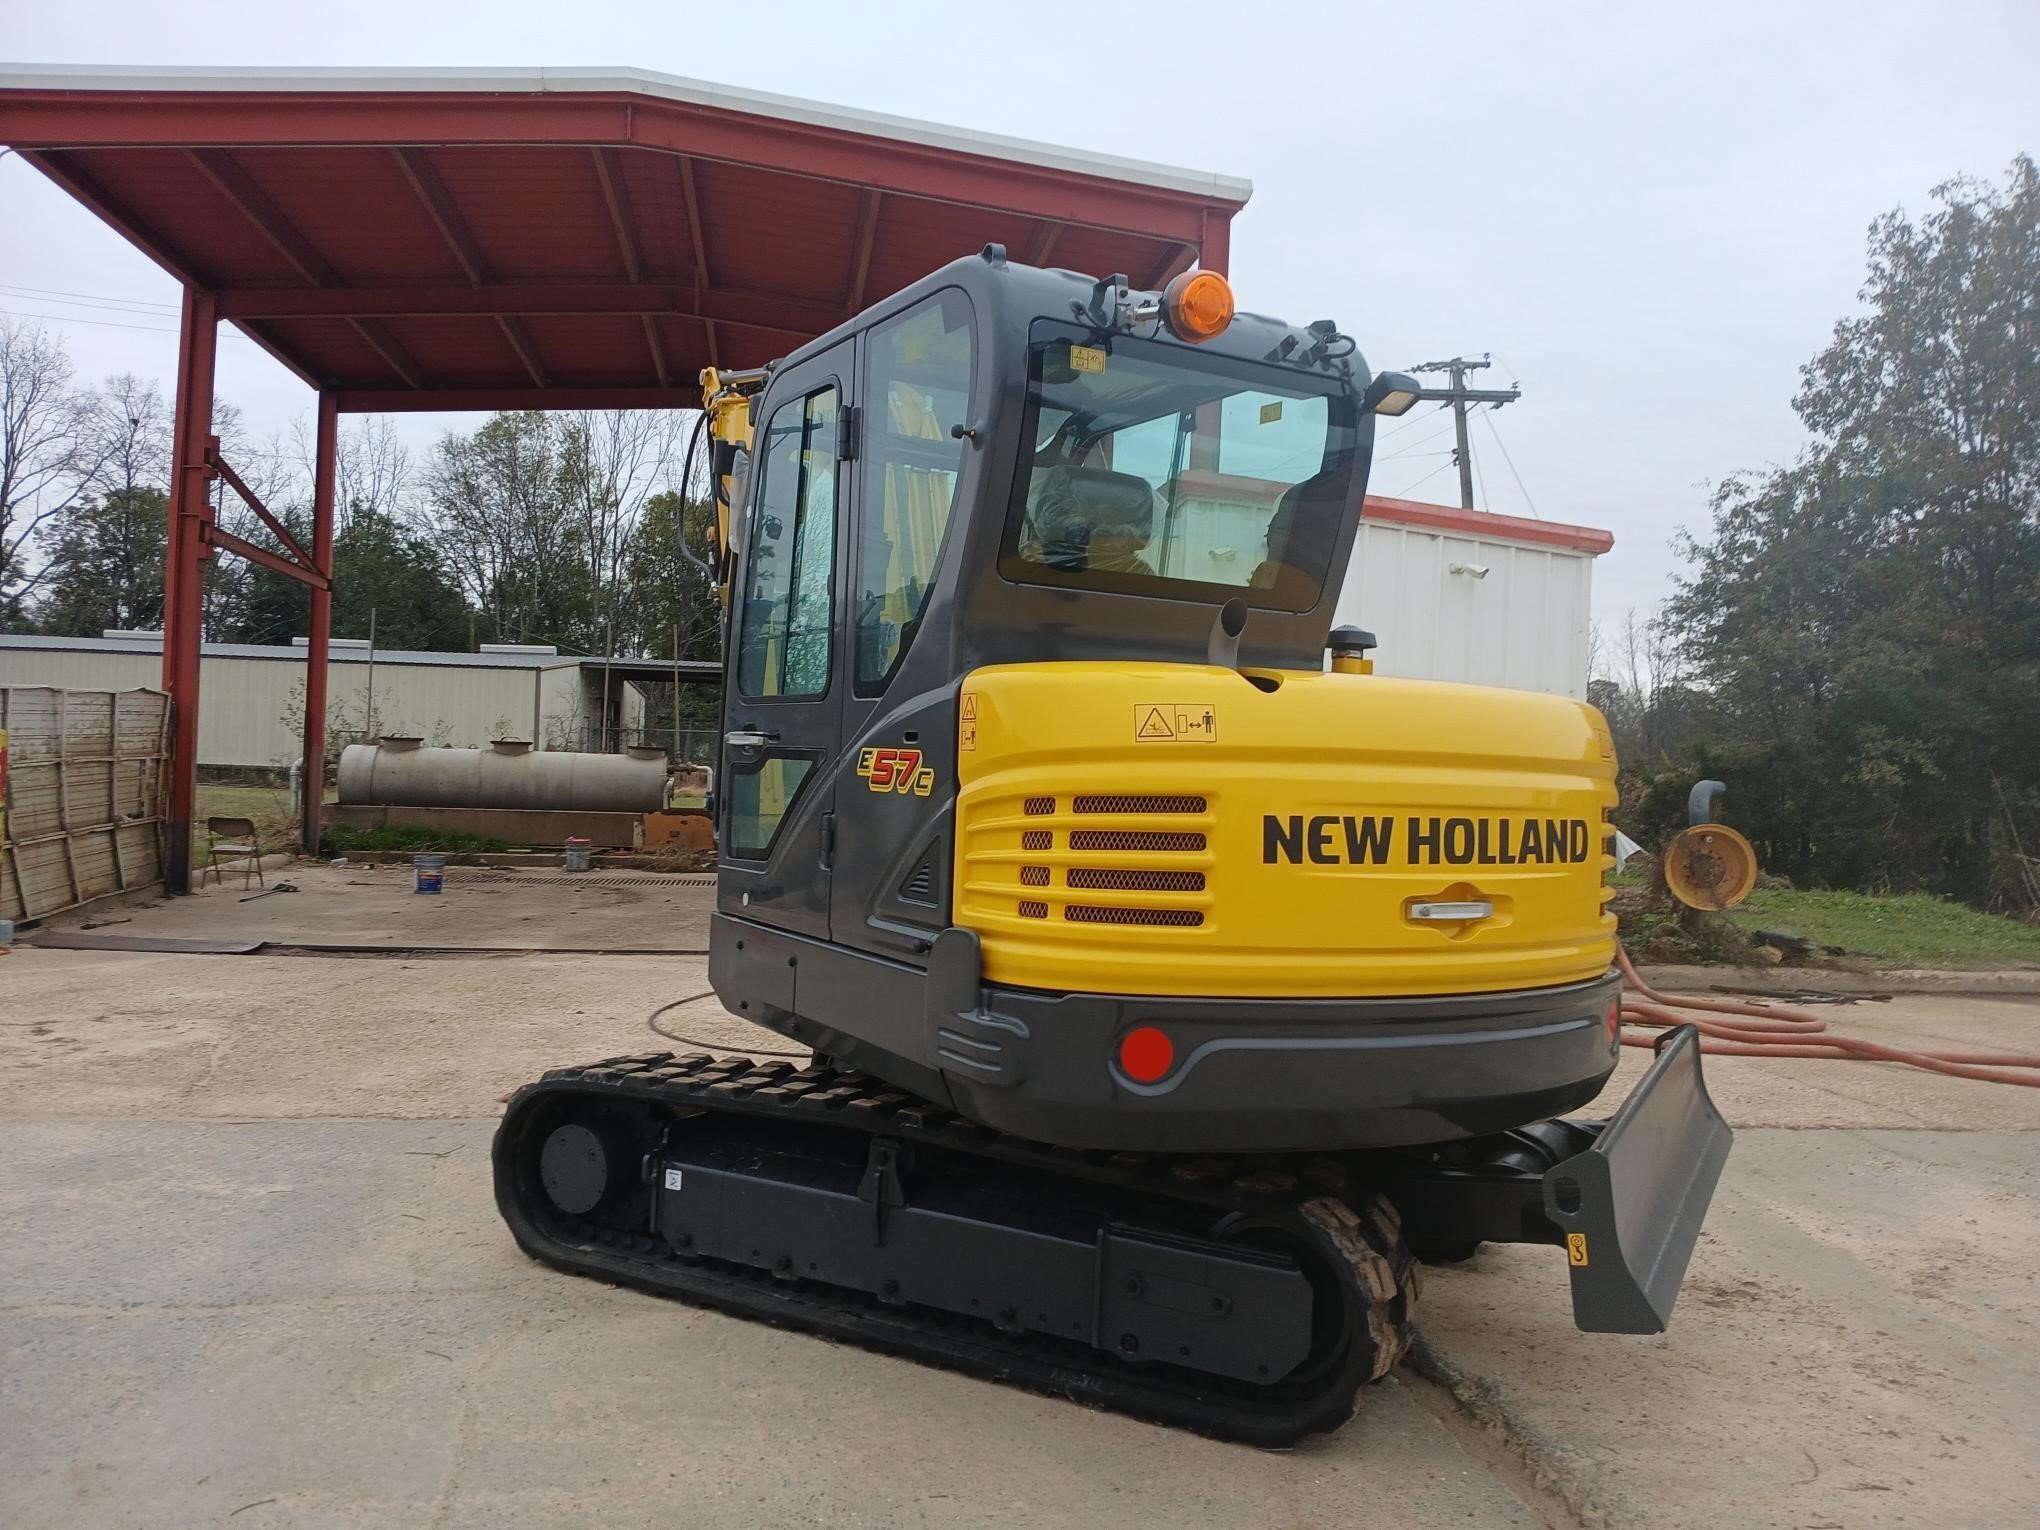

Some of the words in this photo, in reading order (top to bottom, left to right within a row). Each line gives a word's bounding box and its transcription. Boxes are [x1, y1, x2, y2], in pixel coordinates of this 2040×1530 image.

[857, 747, 934, 796] E57C
[1263, 815, 1394, 864] NEW
[1407, 817, 1588, 864] HOLLAND
